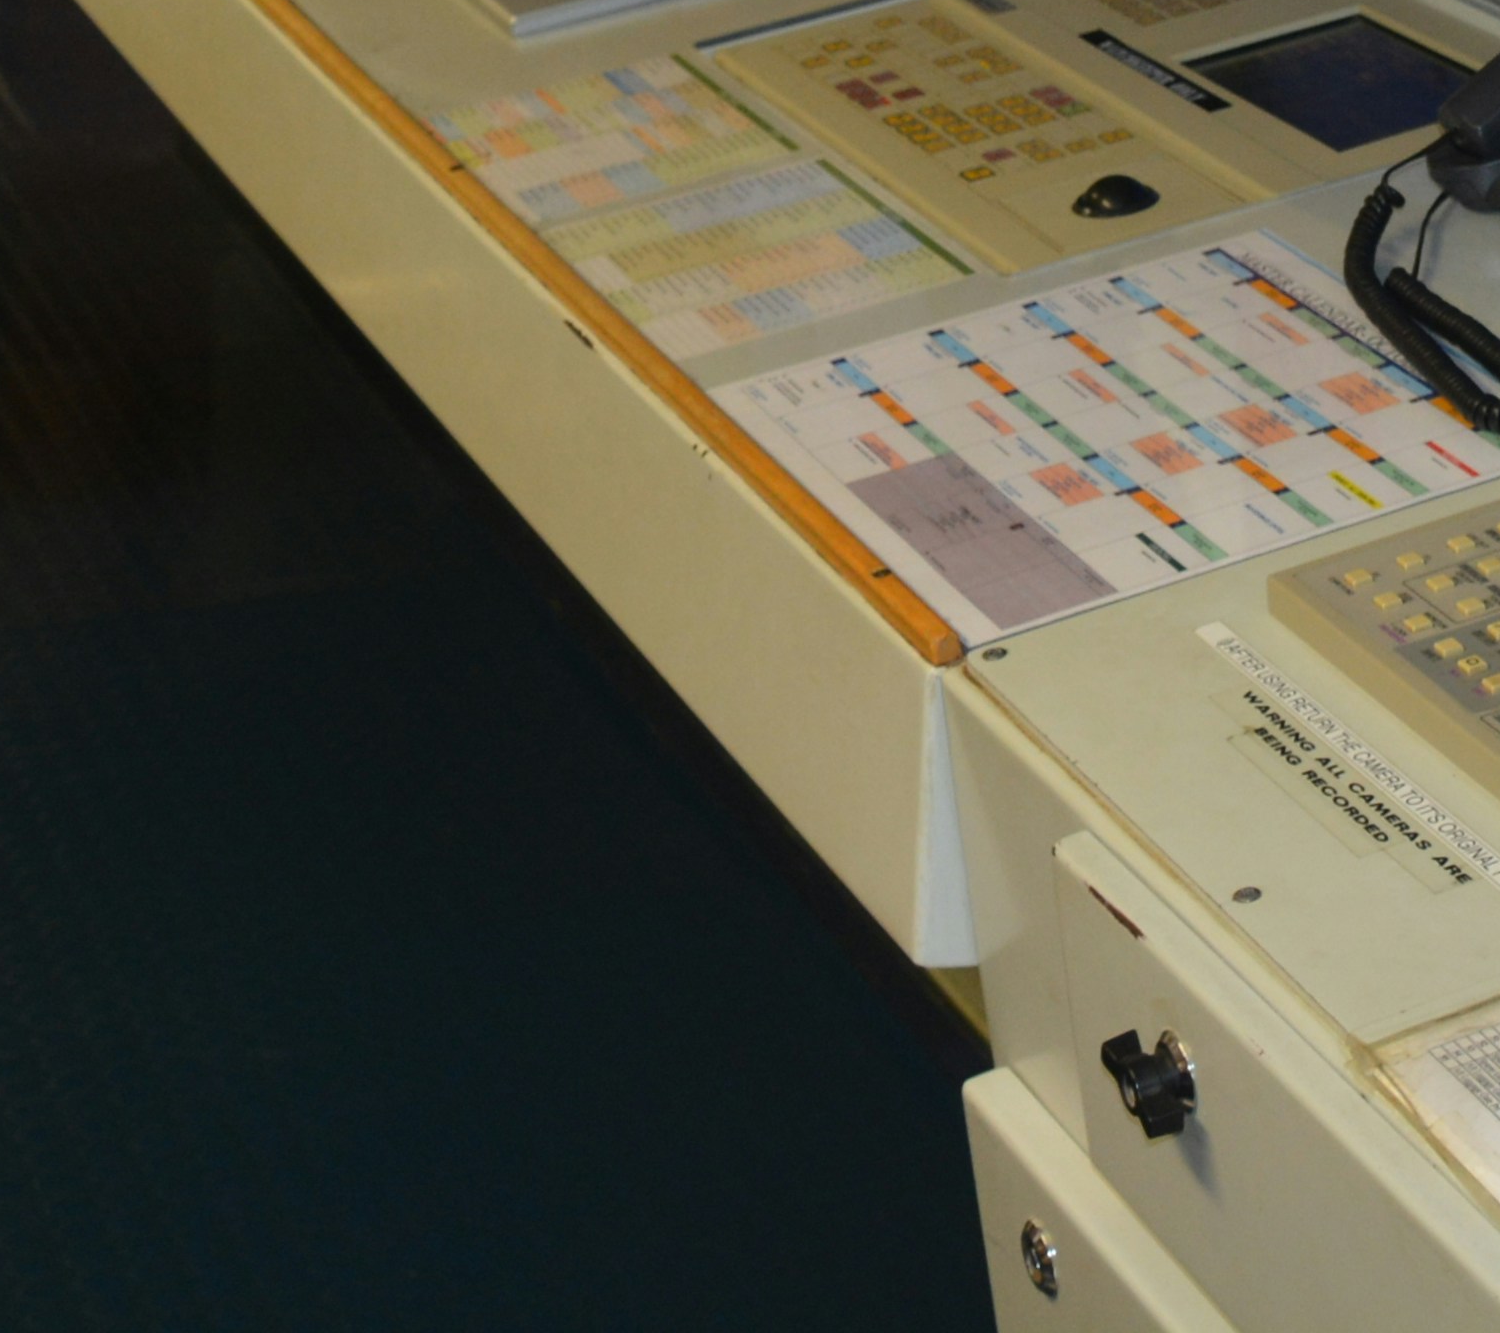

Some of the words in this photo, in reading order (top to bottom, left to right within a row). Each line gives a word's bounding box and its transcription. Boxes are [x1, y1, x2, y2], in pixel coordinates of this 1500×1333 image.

[1242, 690, 1318, 753] WARNING
[1316, 754, 1346, 780] ALL
[1348, 782, 1432, 851] CAMERAS
[1432, 853, 1473, 885] ARE
[1253, 726, 1303, 767] BEING
[1302, 769, 1389, 845] RECORDED
